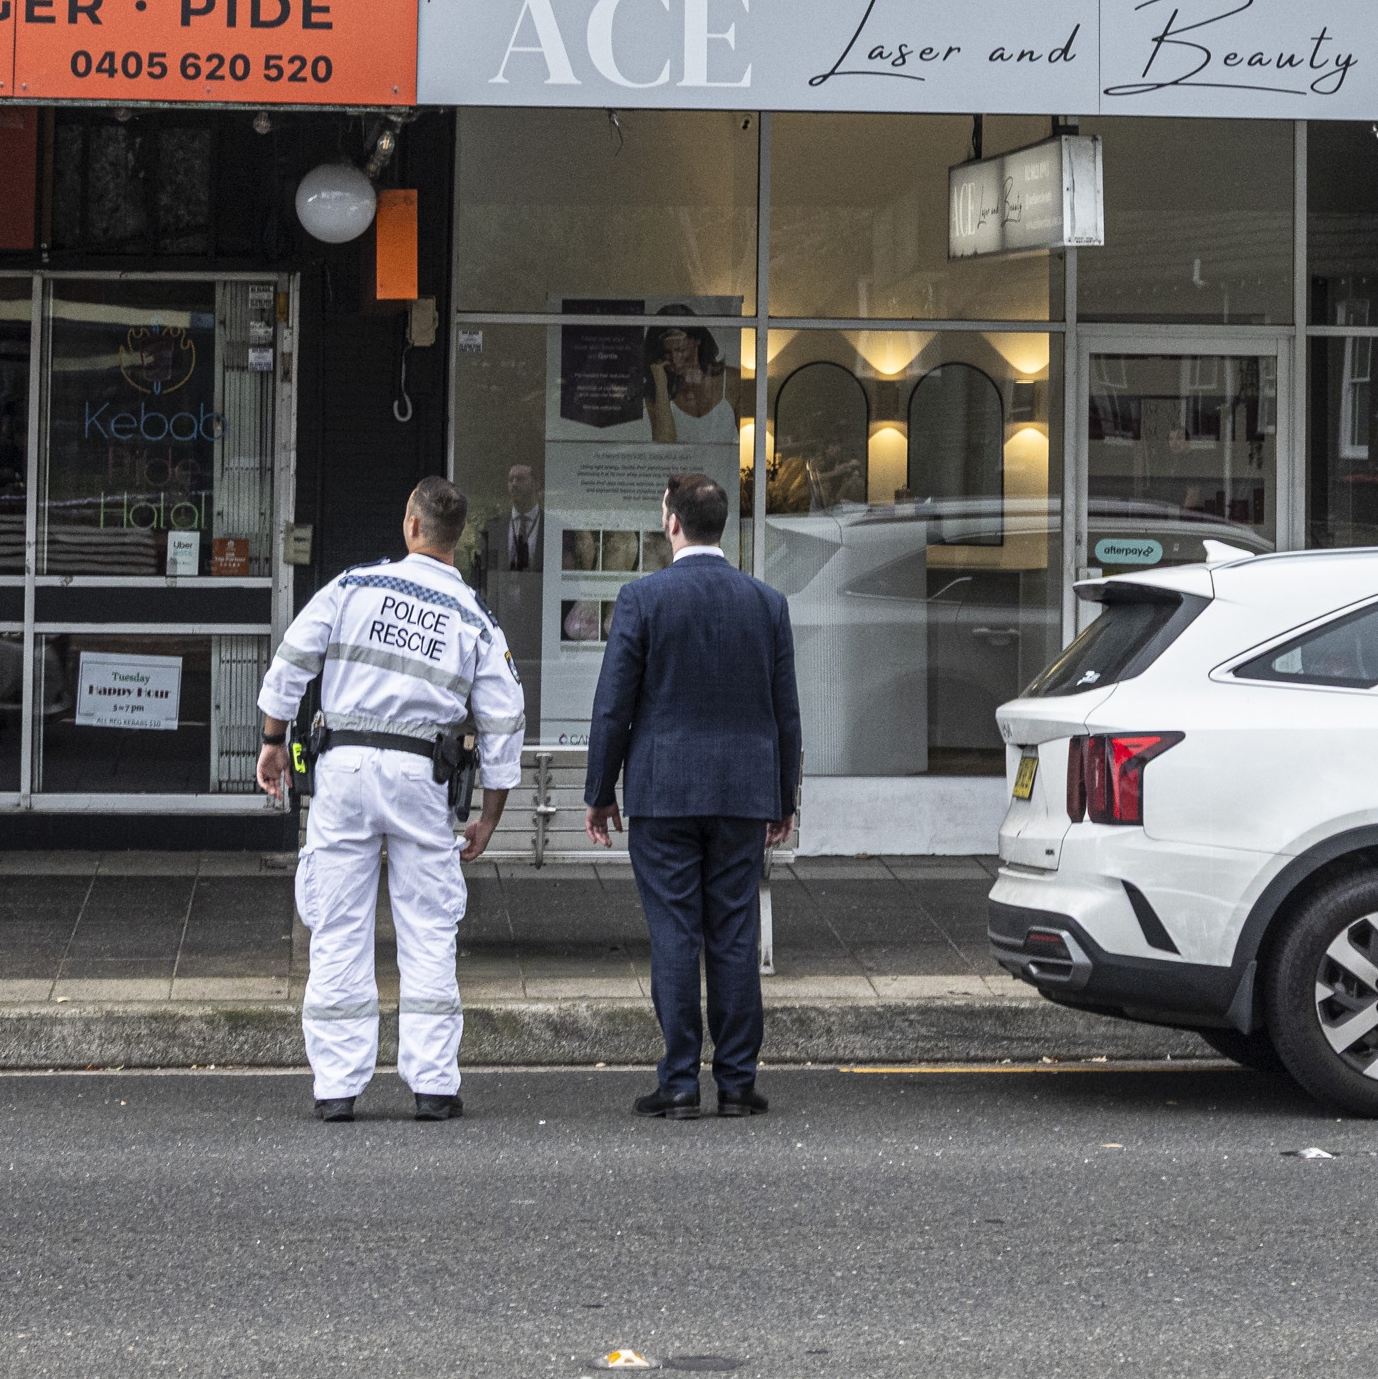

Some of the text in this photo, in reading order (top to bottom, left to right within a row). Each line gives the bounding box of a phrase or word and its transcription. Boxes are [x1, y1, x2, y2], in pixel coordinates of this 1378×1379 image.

[988, 24, 1080, 64] and
[69, 50, 334, 83] 0405 620 520
[84, 402, 227, 441] Kebab
[99, 492, 206, 530] Halal
[173, 541, 193, 549] Uber
[1104, 546, 1143, 558] afterpay
[380, 596, 450, 635] POLICE
[369, 620, 446, 662] RESCUE
[88, 685, 171, 699] Happy Hour
[112, 672, 150, 685] Tuesday
